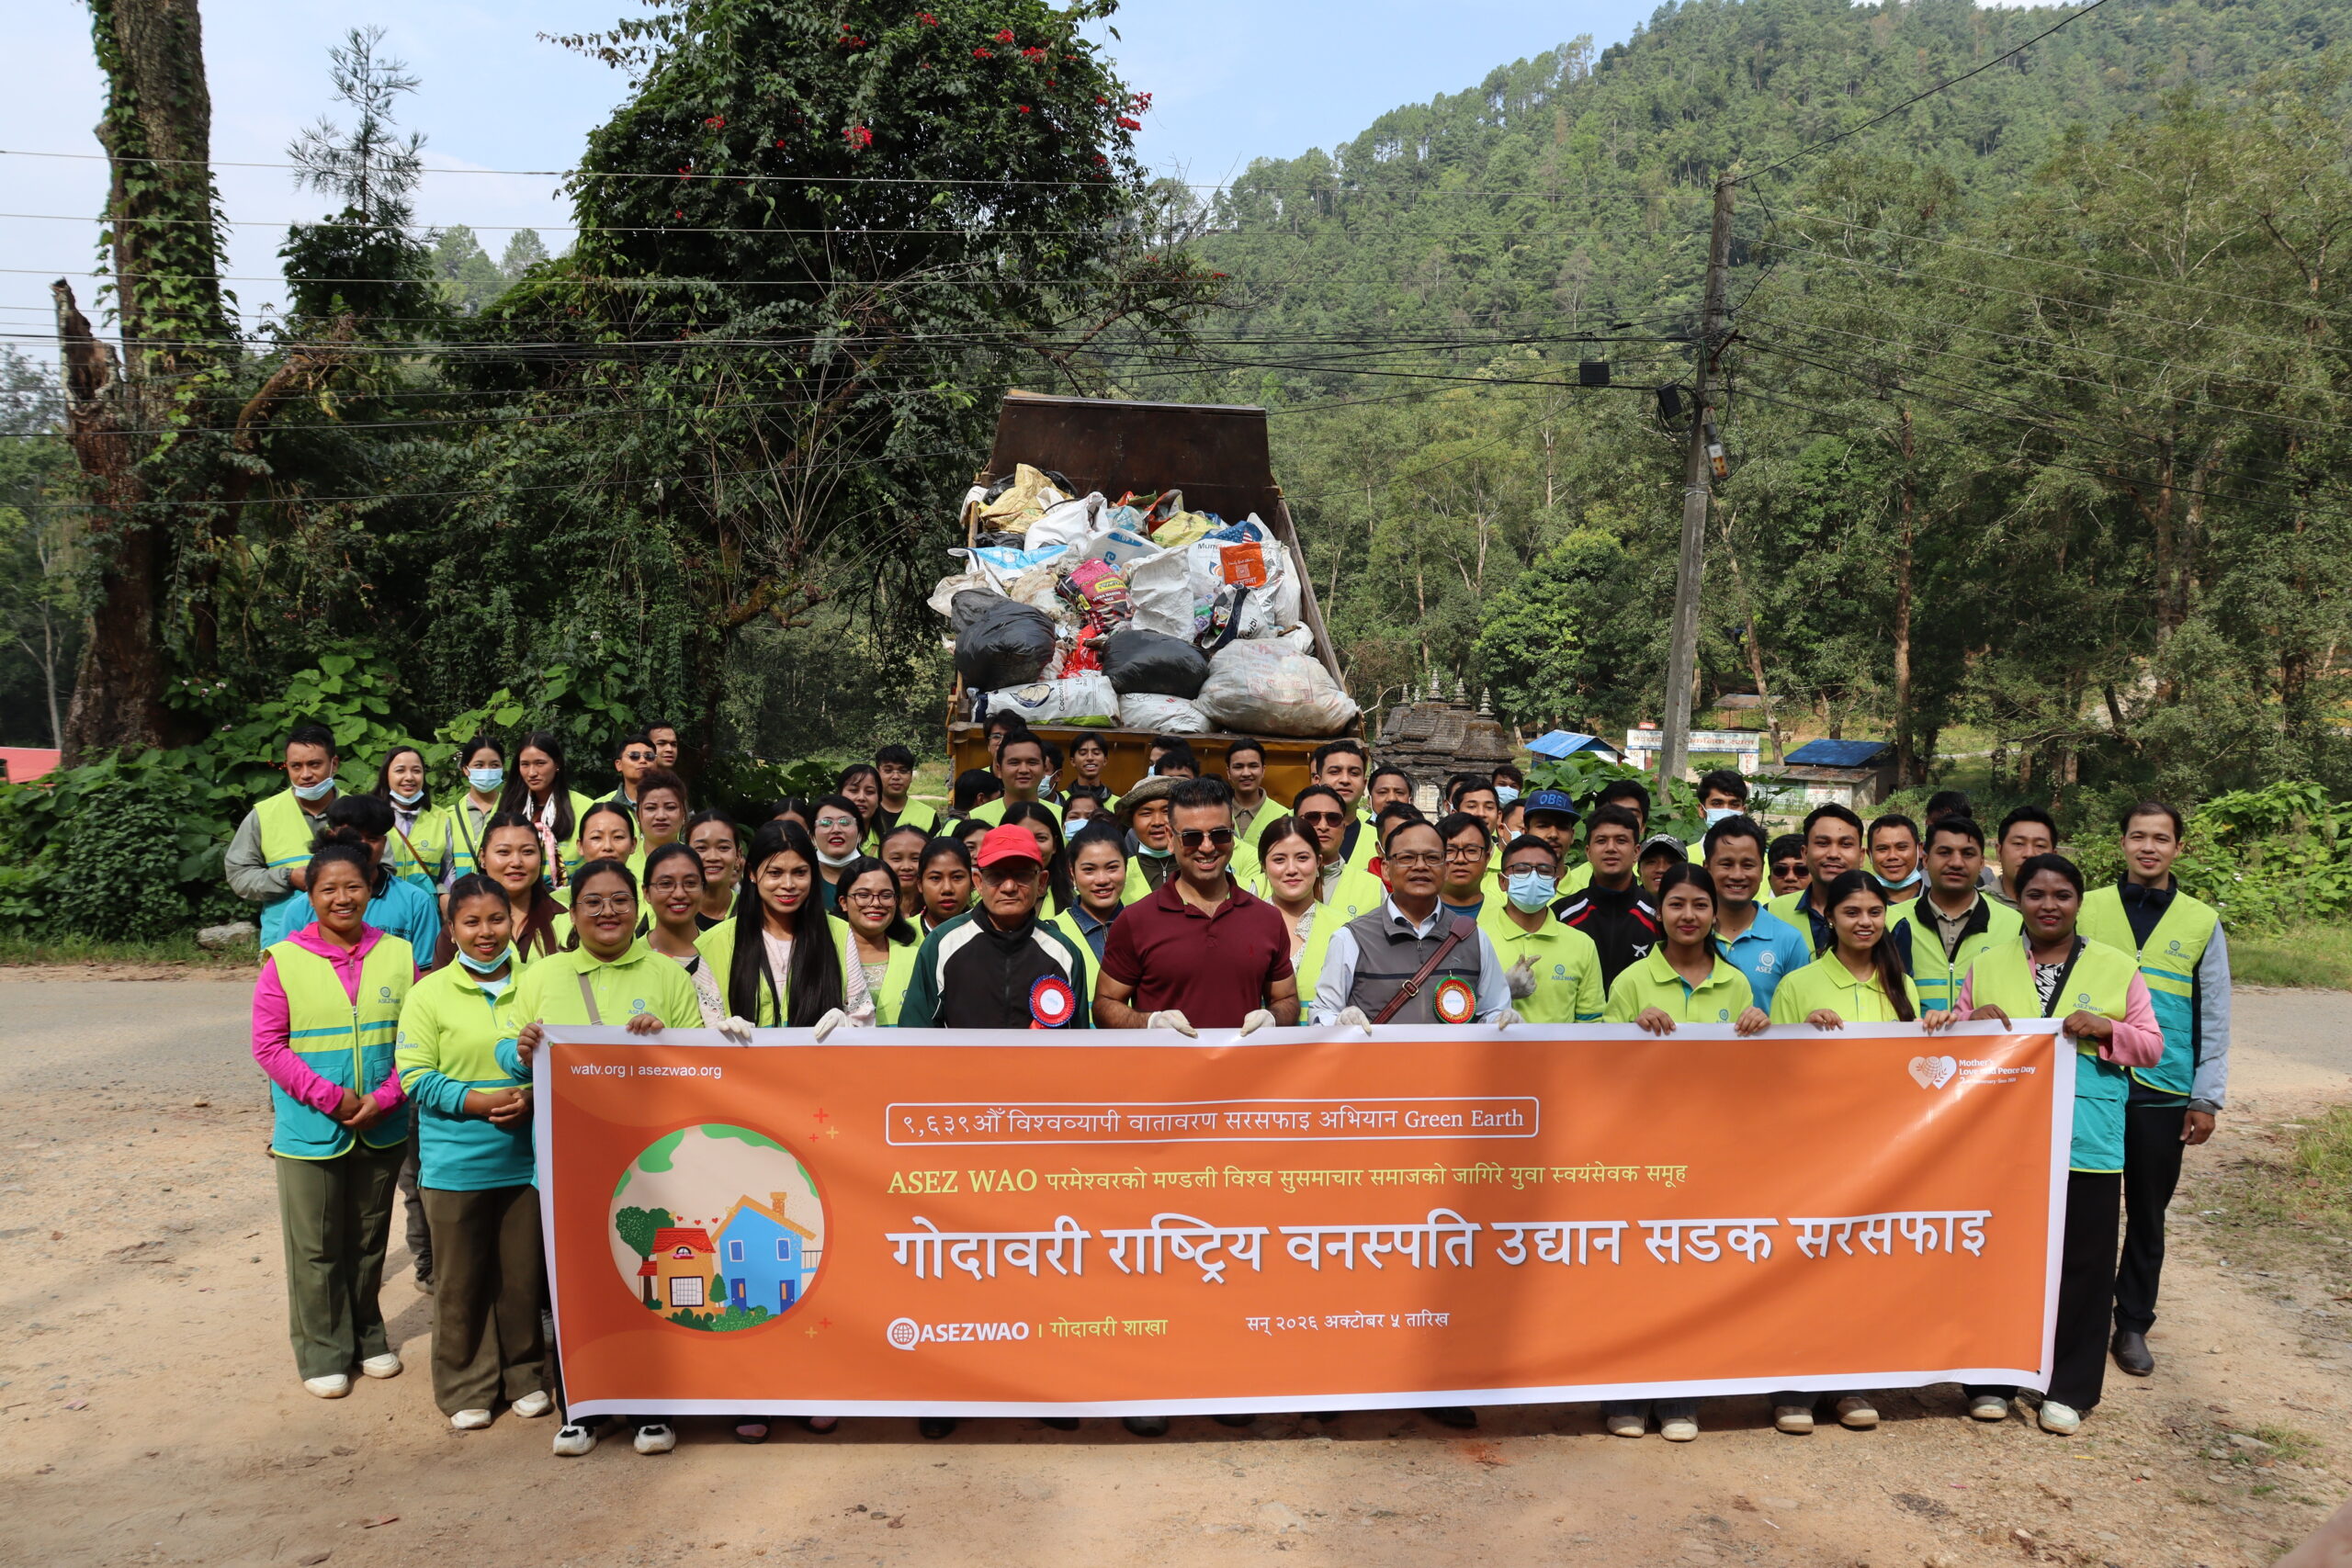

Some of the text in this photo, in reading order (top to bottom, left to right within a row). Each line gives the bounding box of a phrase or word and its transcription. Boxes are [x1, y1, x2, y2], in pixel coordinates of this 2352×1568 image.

[1755, 965, 1772, 975] ASEZ
[571, 1063, 722, 1079] watv.org asezwao.org
[2020, 1066, 2036, 1074] Day
[1007, 1109, 1121, 1133] विश्वव्यापी
[1127, 1112, 1218, 1132] वातावरण
[1223, 1111, 1312, 1132] सरसफाइ
[1317, 1105, 1398, 1130] अभियान
[1405, 1107, 1464, 1128] Green
[1470, 1108, 1525, 1128] Earth
[887, 1160, 1689, 1194] ASEZ WAO परमेश्वरको मण्डली विश्व सुसमाचार समाजको जागिरे युवा स्वयंसेवक समूह
[884, 1207, 1993, 1284] गोदावरी राष्ट्रिय वनस्पति उद्यान सडक सरसफाइ
[920, 1315, 1169, 1343] ASEZWAO गोदावरी शाखा
[1246, 1316, 1272, 1336] सन्
[1276, 1314, 1318, 1331] २०२६
[1323, 1310, 1385, 1329] अक्टोबर
[1405, 1309, 1451, 1328] तारिख
